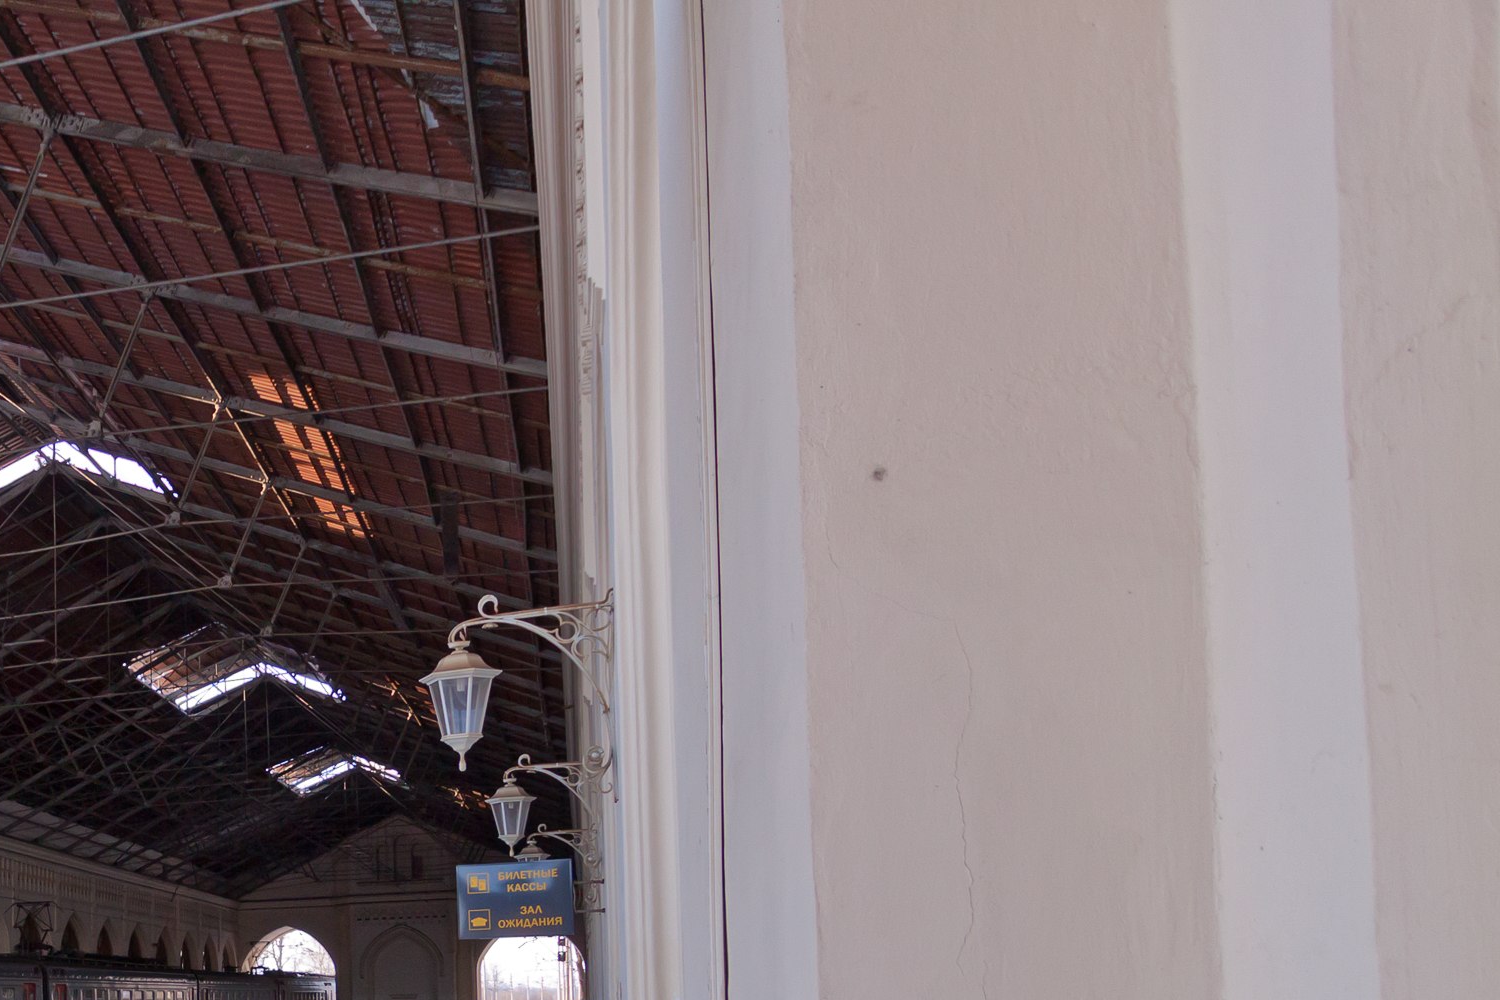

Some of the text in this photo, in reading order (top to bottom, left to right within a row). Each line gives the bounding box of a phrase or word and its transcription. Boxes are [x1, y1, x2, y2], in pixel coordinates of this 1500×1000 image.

[498, 868, 558, 881] БИЛЕТНЫЕ
[507, 882, 546, 892] КАССЫ
[520, 905, 542, 915] ЗАЛ
[498, 917, 562, 928] ОЖИДАНИЯ
